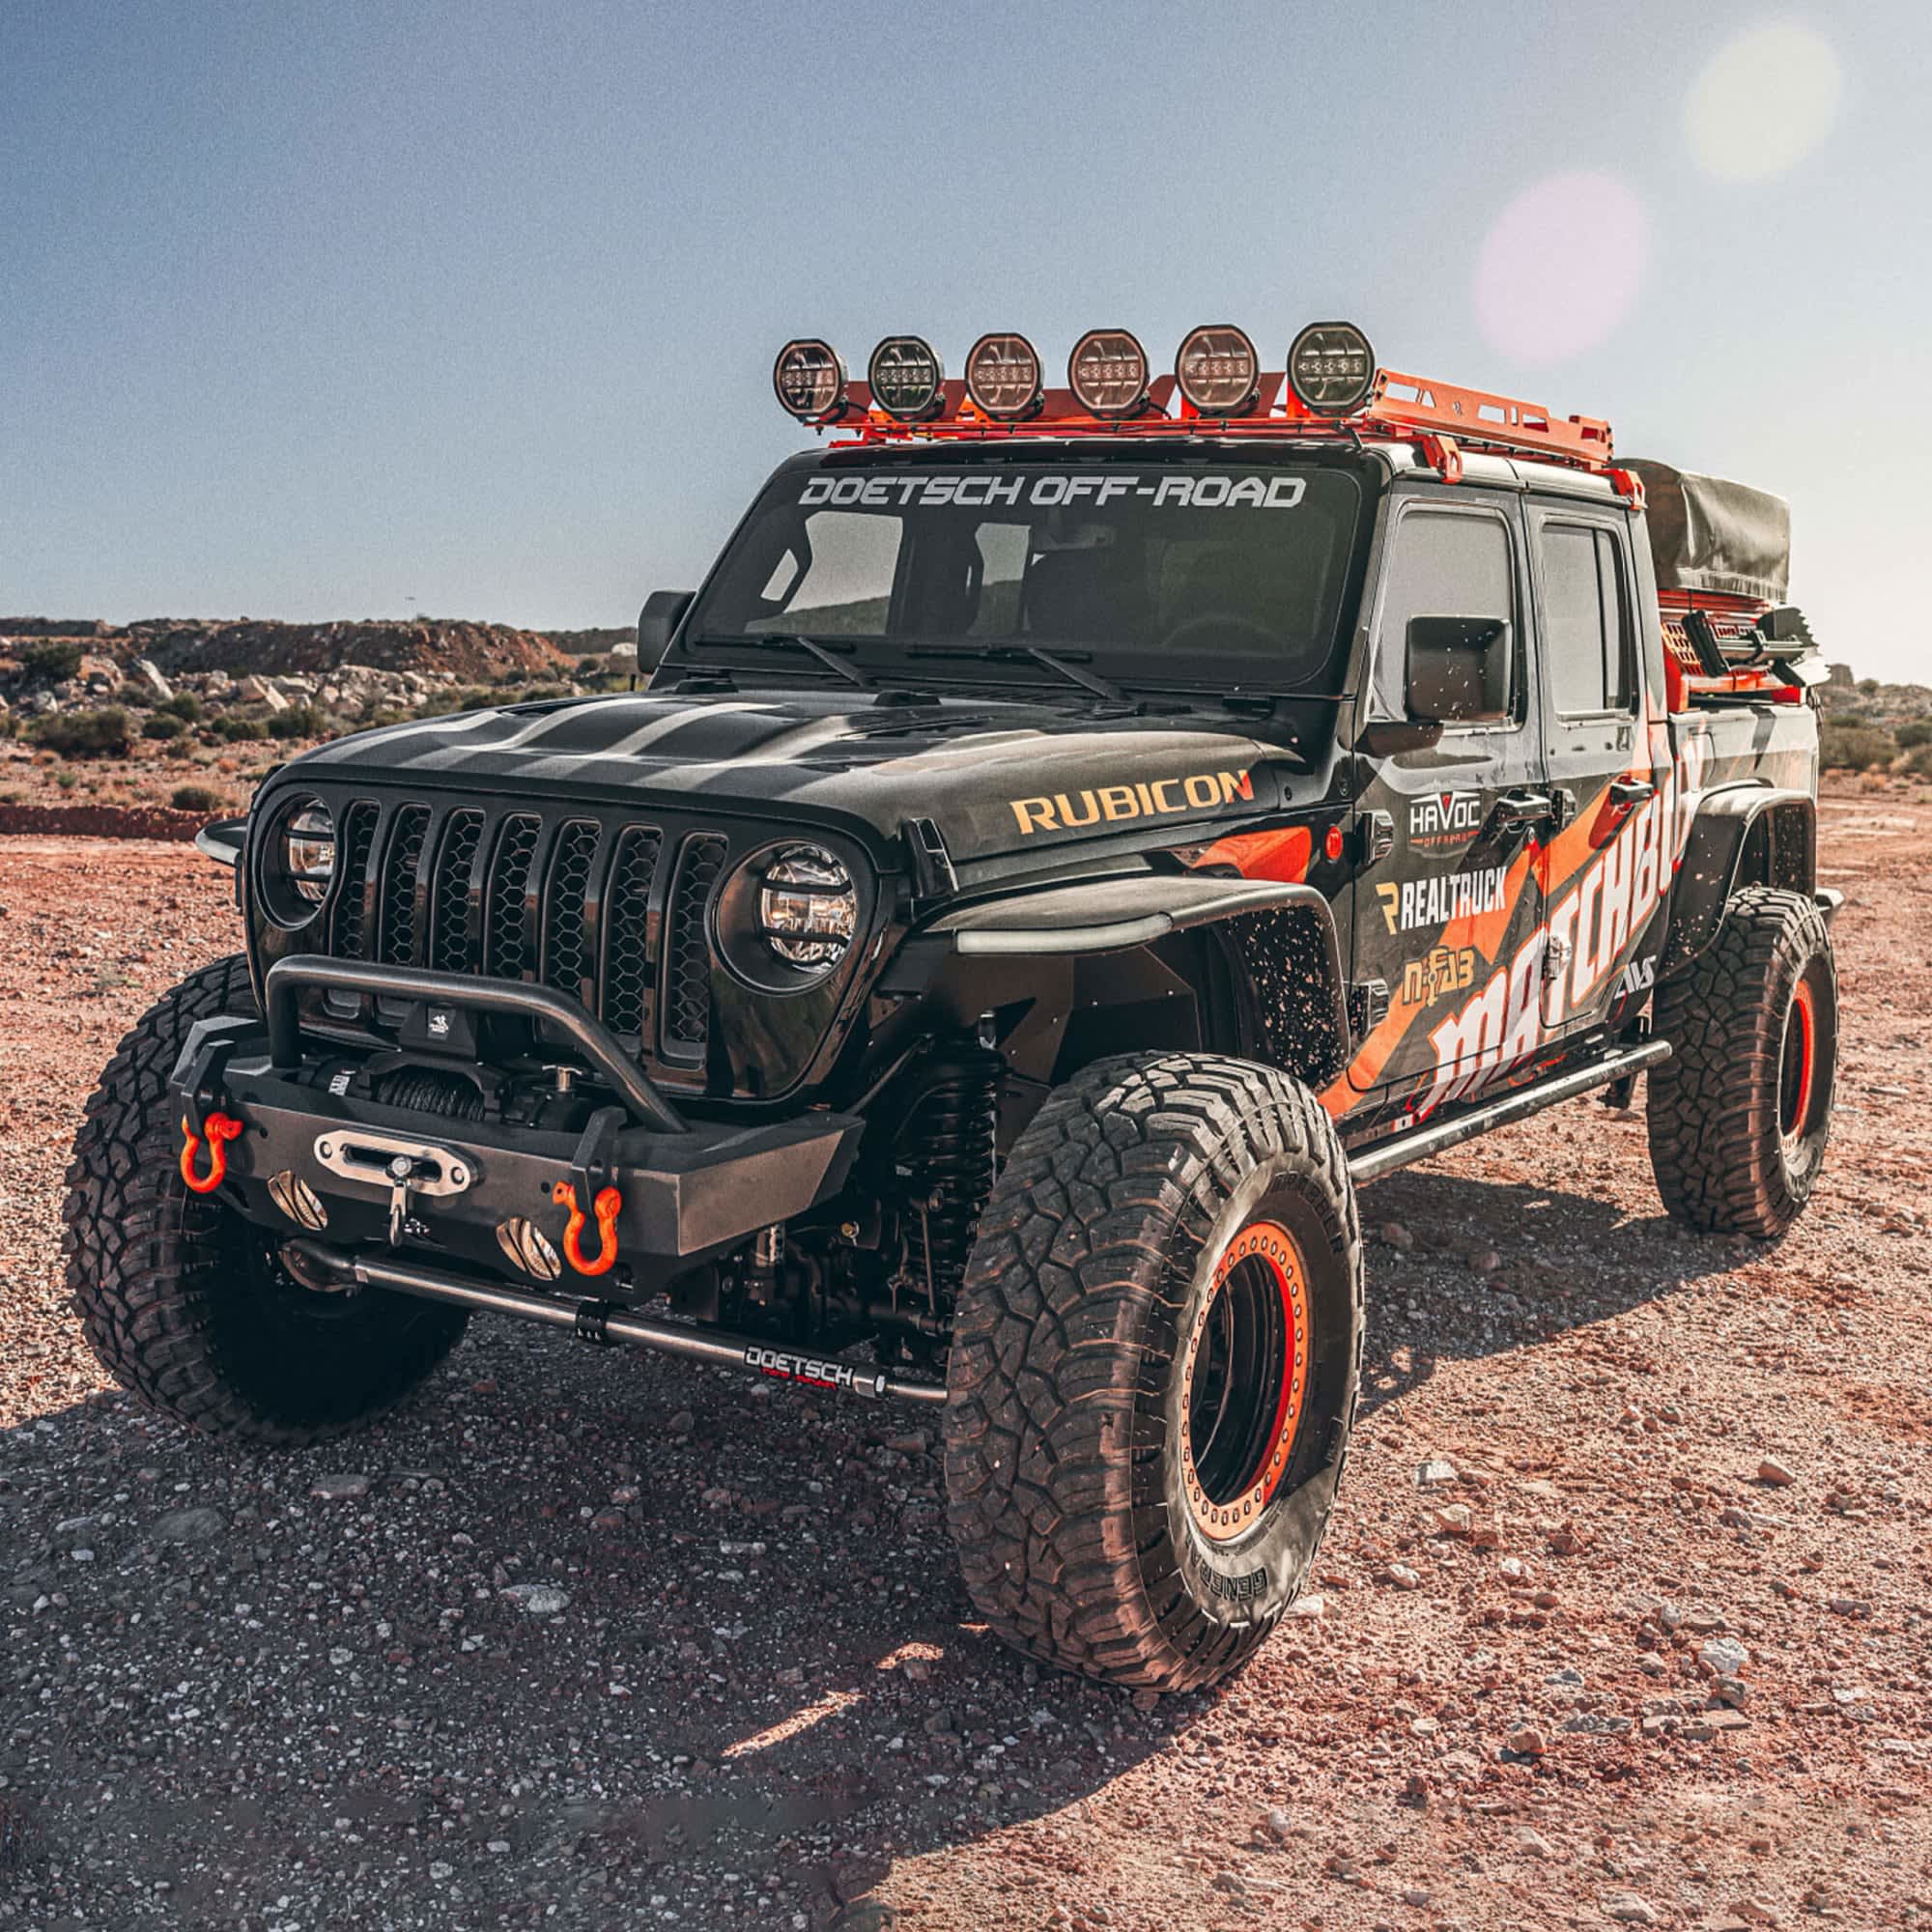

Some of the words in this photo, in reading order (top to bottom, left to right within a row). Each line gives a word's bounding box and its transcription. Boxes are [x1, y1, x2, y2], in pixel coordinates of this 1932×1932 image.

[798, 476, 1025, 505] DOETSCH
[1029, 476, 1307, 508] OFF-ROAD
[1009, 770, 1255, 835] RUBICON
[1409, 790, 1481, 835] HAVOC
[1401, 866, 1508, 930] REALTRUCK
[746, 1346, 854, 1386] DOETSCH
